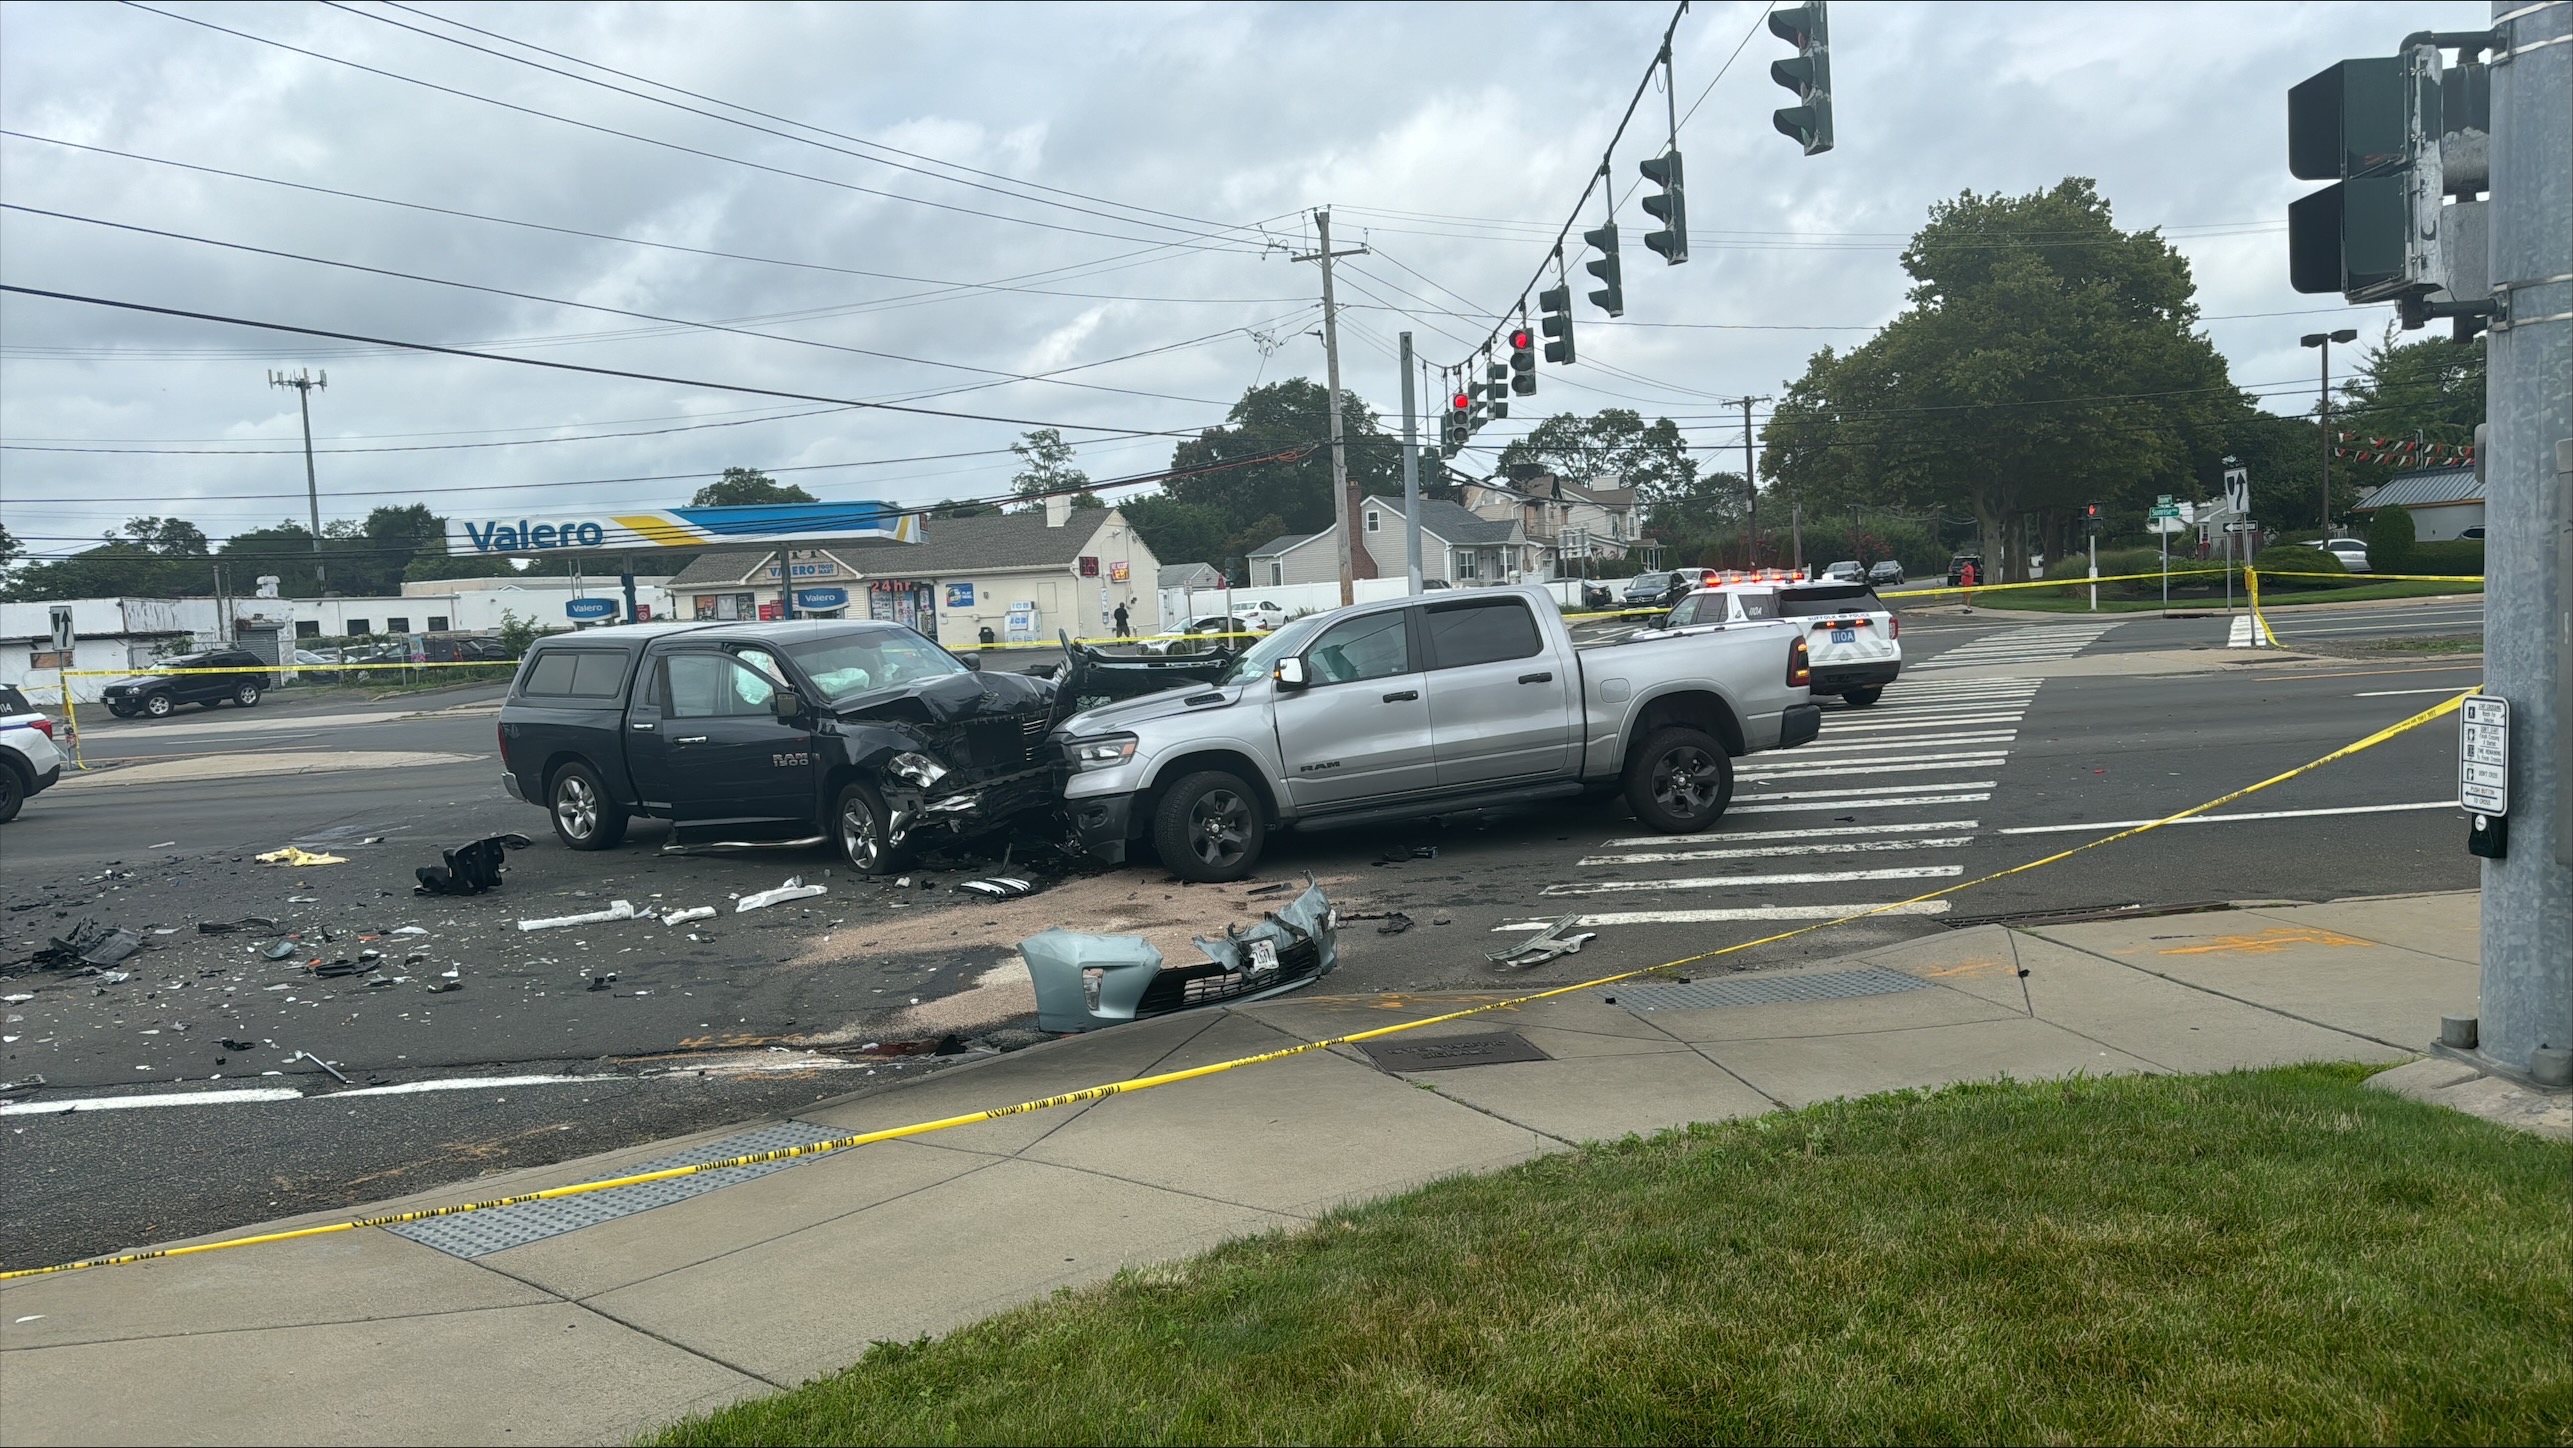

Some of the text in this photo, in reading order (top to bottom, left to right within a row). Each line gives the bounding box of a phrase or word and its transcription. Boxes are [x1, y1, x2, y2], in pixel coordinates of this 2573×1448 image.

[2151, 508, 2171, 516] Sunrise
[464, 519, 603, 551] Valero
[805, 594, 836, 602] Valero
[572, 603, 603, 613] Valero
[772, 752, 808, 760] RAM
[773, 759, 809, 767] 1500
[1300, 761, 1341, 773] RAM
[2481, 788, 2495, 796] BUTTON
